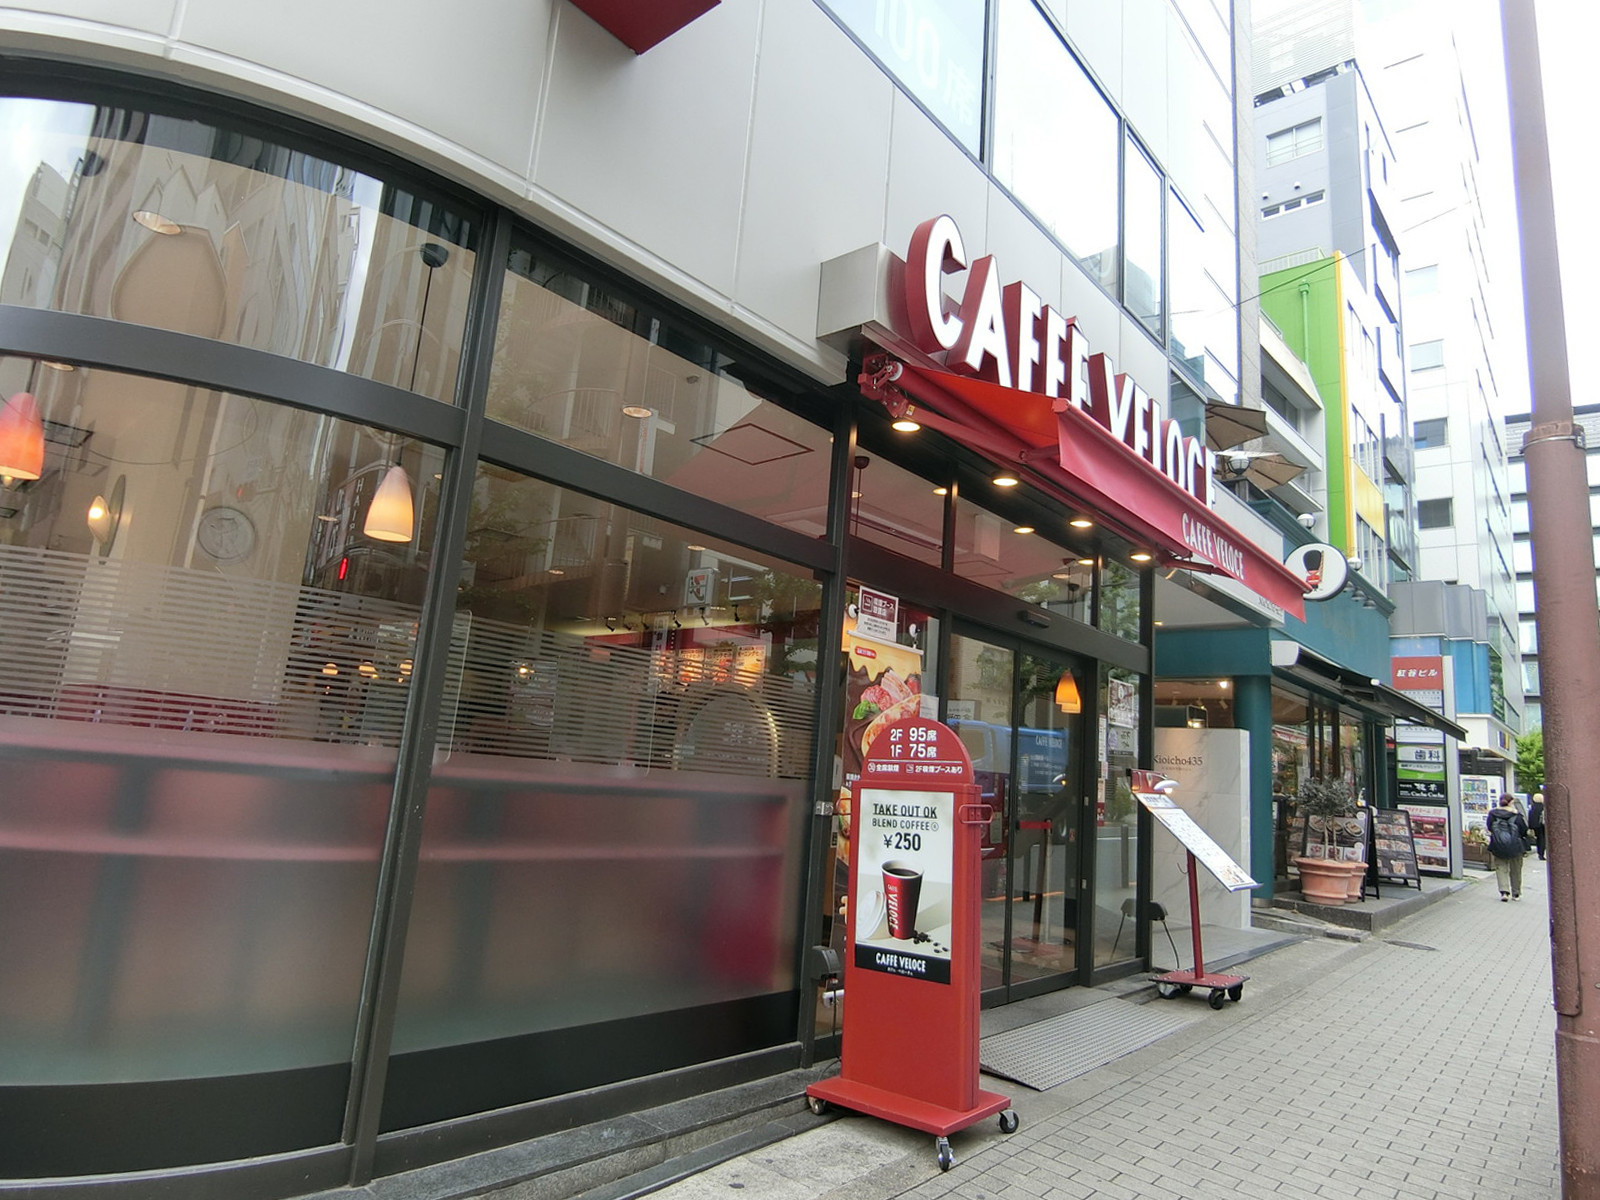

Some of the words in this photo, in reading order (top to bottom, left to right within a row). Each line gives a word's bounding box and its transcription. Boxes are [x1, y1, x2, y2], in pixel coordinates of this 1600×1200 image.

[1090, 353, 1217, 509] VELOCE
[1212, 532, 1245, 580] VELOCE
[890, 728, 903, 742] 2F
[909, 727, 937, 742] 95席
[890, 744, 903, 758] 1F
[909, 743, 937, 758] 75席
[1415, 750, 1440, 761] 歯科
[873, 803, 898, 816] TAKE
[900, 805, 920, 817] OUT
[923, 806, 937, 819] OK
[872, 818, 898, 828] BLEND
[900, 819, 930, 831] COFFEE
[883, 832, 922, 852] ¥250
[887, 893, 899, 931] VELOCE
[899, 956, 927, 972] VELOCE
